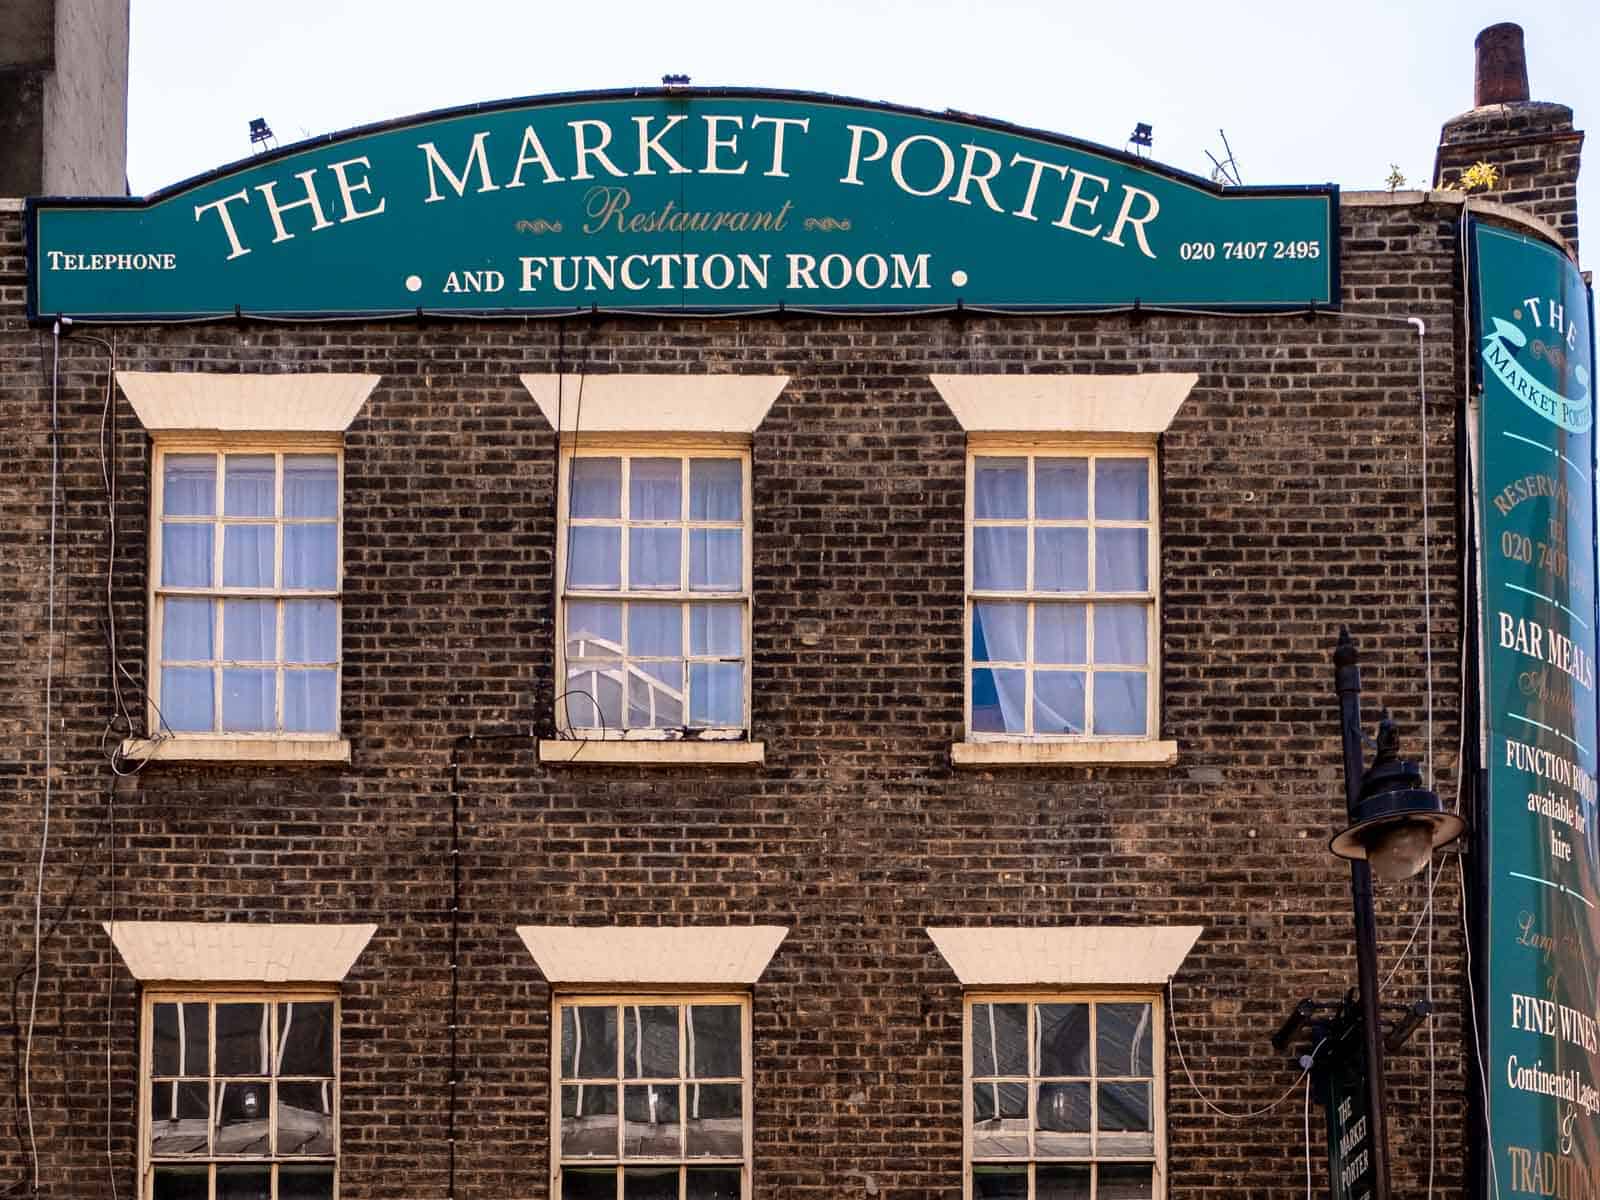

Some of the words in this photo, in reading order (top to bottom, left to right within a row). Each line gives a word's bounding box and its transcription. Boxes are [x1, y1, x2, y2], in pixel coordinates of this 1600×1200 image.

[194, 155, 386, 261] THE
[417, 113, 810, 203] MARKET
[838, 122, 1162, 260] PORTER
[582, 185, 795, 235] Restaurant
[47, 250, 177, 272] TELEPHONE
[1180, 242, 1216, 261] 020
[1222, 241, 1268, 260] 7407
[1273, 240, 1320, 260] 2495
[442, 271, 505, 294] AND
[518, 253, 772, 292] FUNCTION
[785, 253, 931, 290] ROOM
[1524, 297, 1577, 351] THE
[1490, 347, 1558, 417] MARKET
[1502, 531, 1532, 564] 020
[1499, 611, 1543, 660] BAR
[1547, 628, 1592, 692] MEALS
[1506, 739, 1571, 788] FUNCTION
[1528, 790, 1574, 827] available
[1551, 830, 1571, 862] hire
[1511, 993, 1556, 1036] FINE
[1559, 1004, 1598, 1055] WINES
[1507, 1055, 1574, 1103] Continental
[1338, 1096, 1353, 1127] THE
[1340, 1115, 1367, 1160] MARKET
[1342, 1150, 1369, 1192] PORTER
